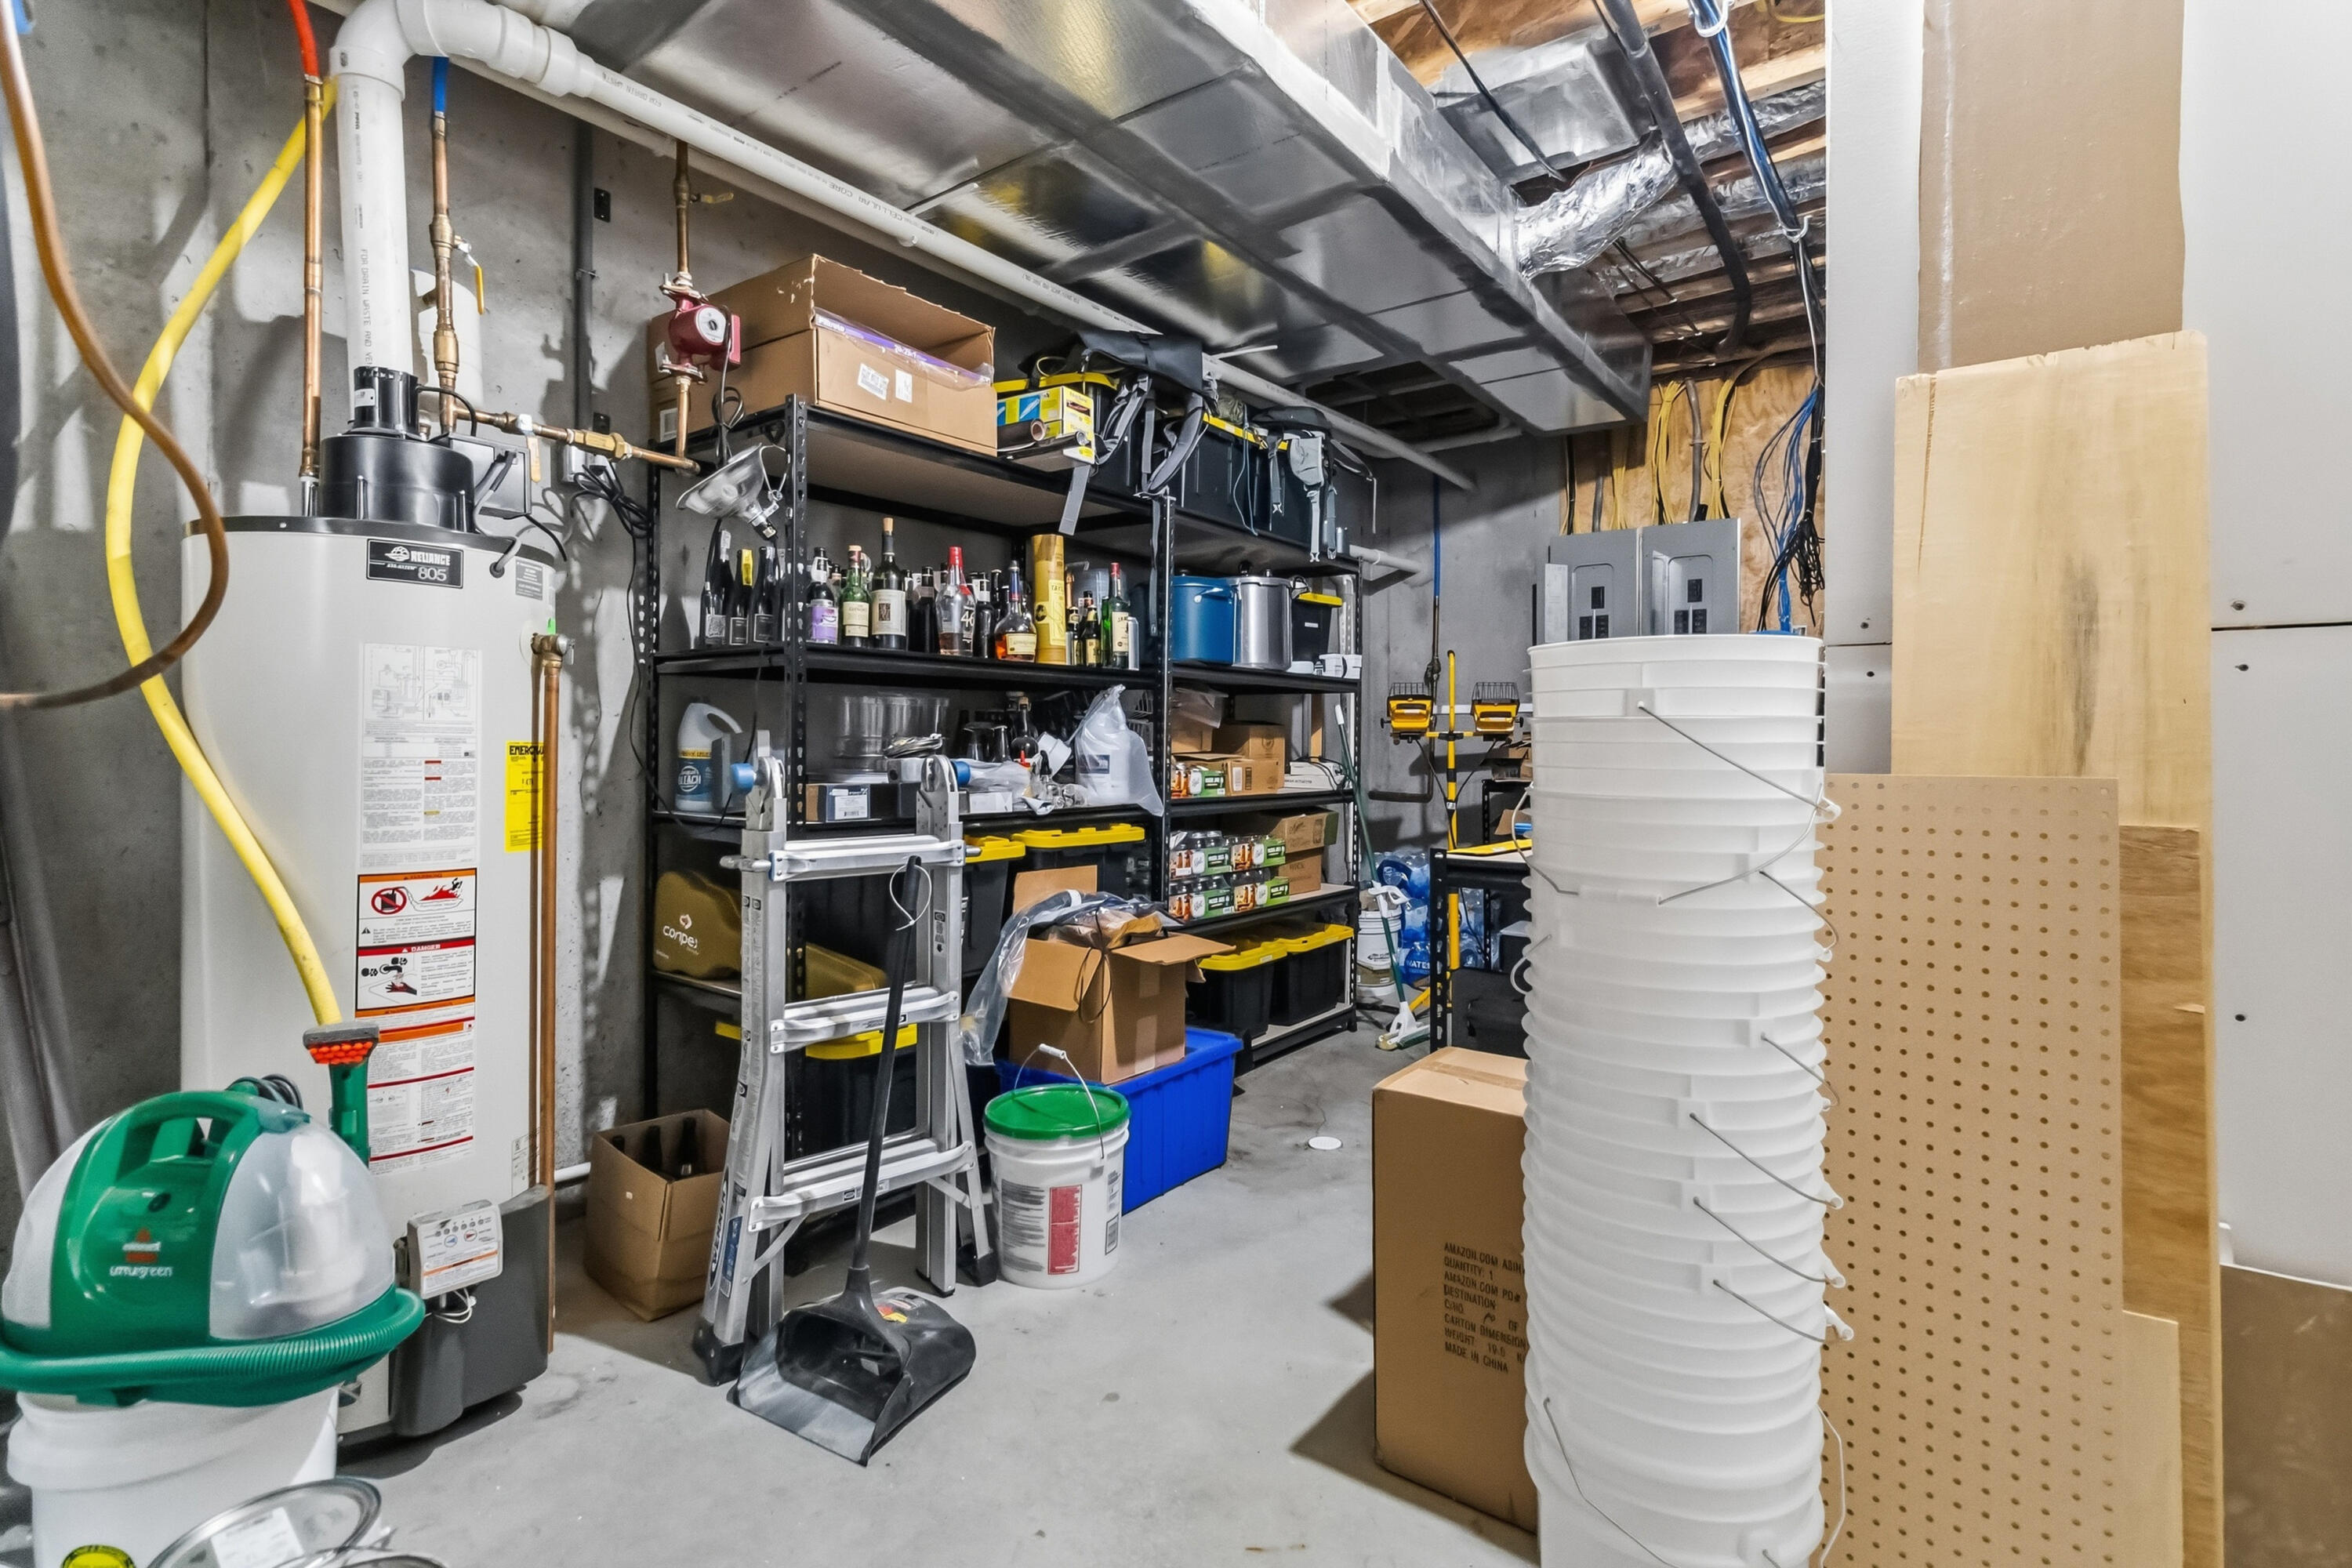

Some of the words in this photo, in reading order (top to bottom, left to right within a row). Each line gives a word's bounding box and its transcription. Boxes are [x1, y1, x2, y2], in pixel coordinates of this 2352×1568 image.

[828, 181, 853, 198] CORE
[361, 267, 369, 295] DRAIN
[411, 550, 451, 566] RELIANCE
[418, 566, 447, 581] 805
[411, 944, 441, 953] DANGER
[1489, 1270, 1494, 1280] 1
[1444, 1341, 1468, 1359] MADE
[1471, 1350, 1479, 1363] IN
[1483, 1355, 1508, 1374] CHINA
